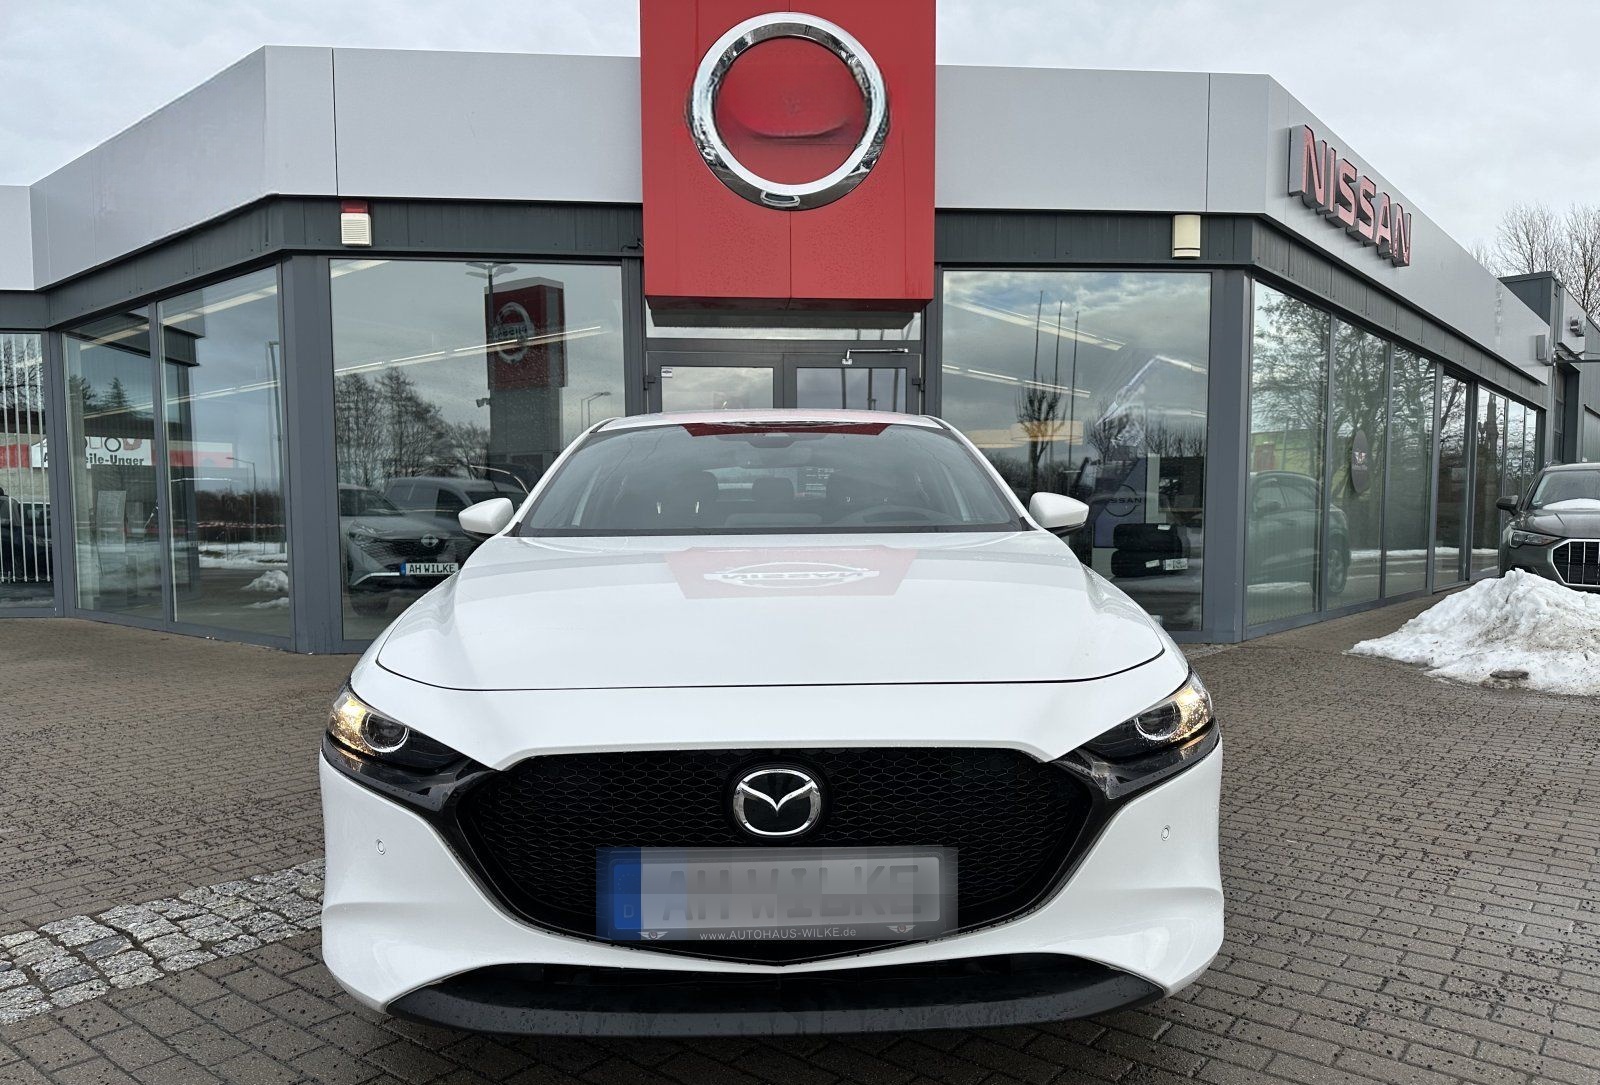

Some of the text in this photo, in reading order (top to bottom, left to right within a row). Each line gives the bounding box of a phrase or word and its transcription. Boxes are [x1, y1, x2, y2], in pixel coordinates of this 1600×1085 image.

[1295, 124, 1412, 267] NISSAN
[409, 563, 456, 574] AH WILKE
[699, 927, 857, 940] www.AUTOHAUS-WILKE.de
